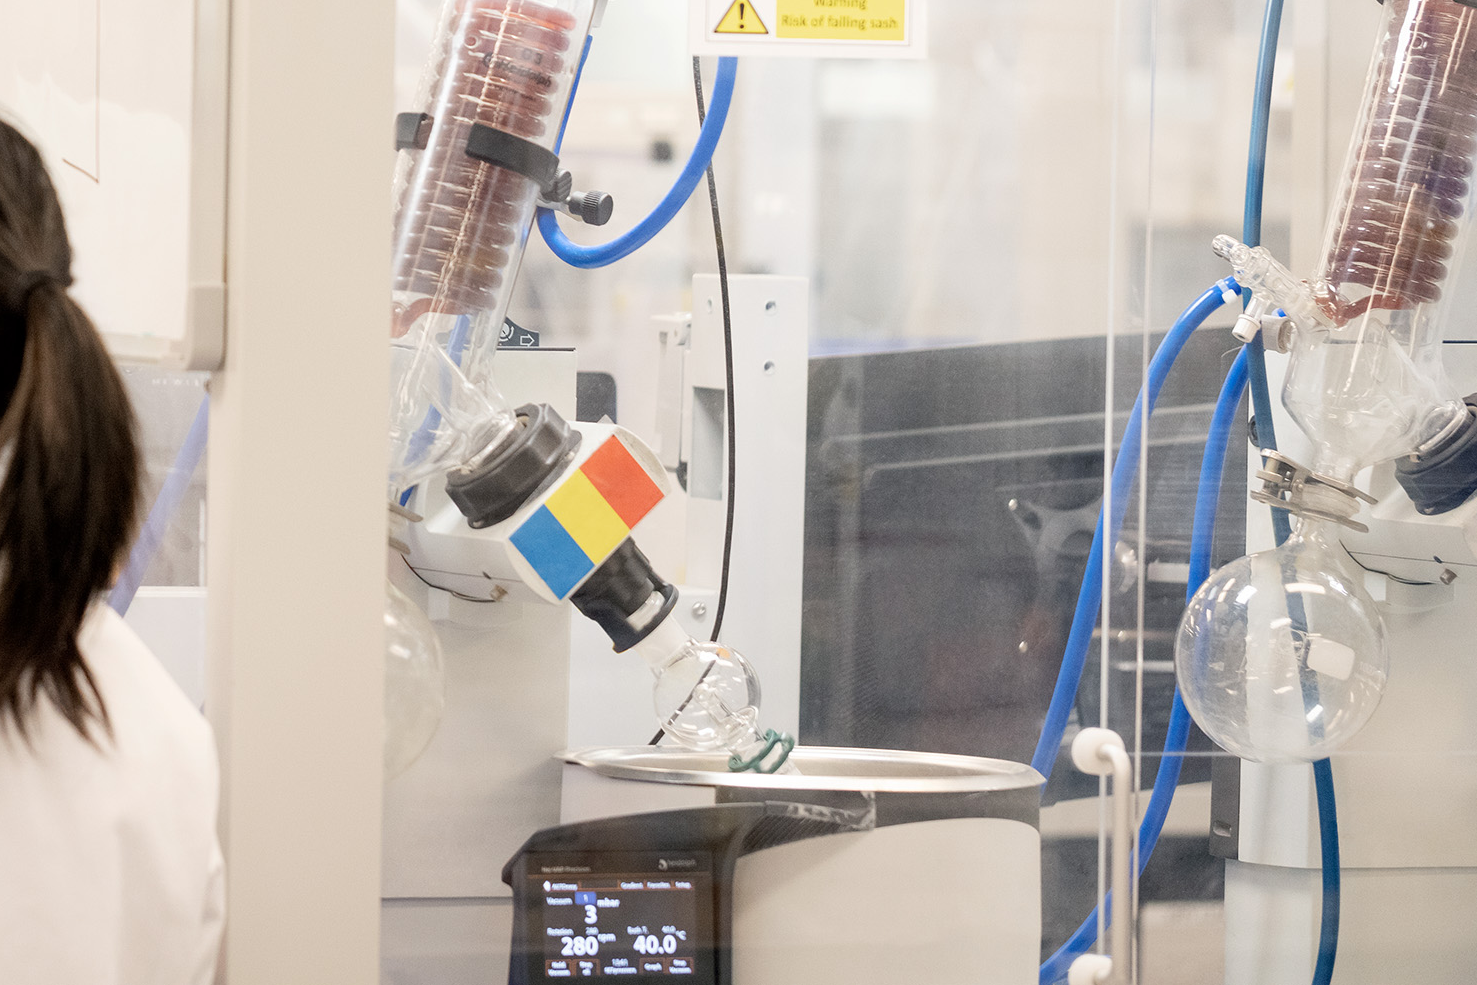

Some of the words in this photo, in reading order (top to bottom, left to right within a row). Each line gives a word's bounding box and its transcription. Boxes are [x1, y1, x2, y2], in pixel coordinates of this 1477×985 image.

[781, 14, 806, 27] Risk
[810, 15, 825, 27] of
[827, 16, 867, 31] falling
[870, 16, 898, 29] sash
[597, 897, 620, 908] mbar
[584, 904, 598, 924] 3
[560, 936, 599, 956] 280
[597, 933, 616, 943] rpm
[633, 934, 677, 954] 40.0
